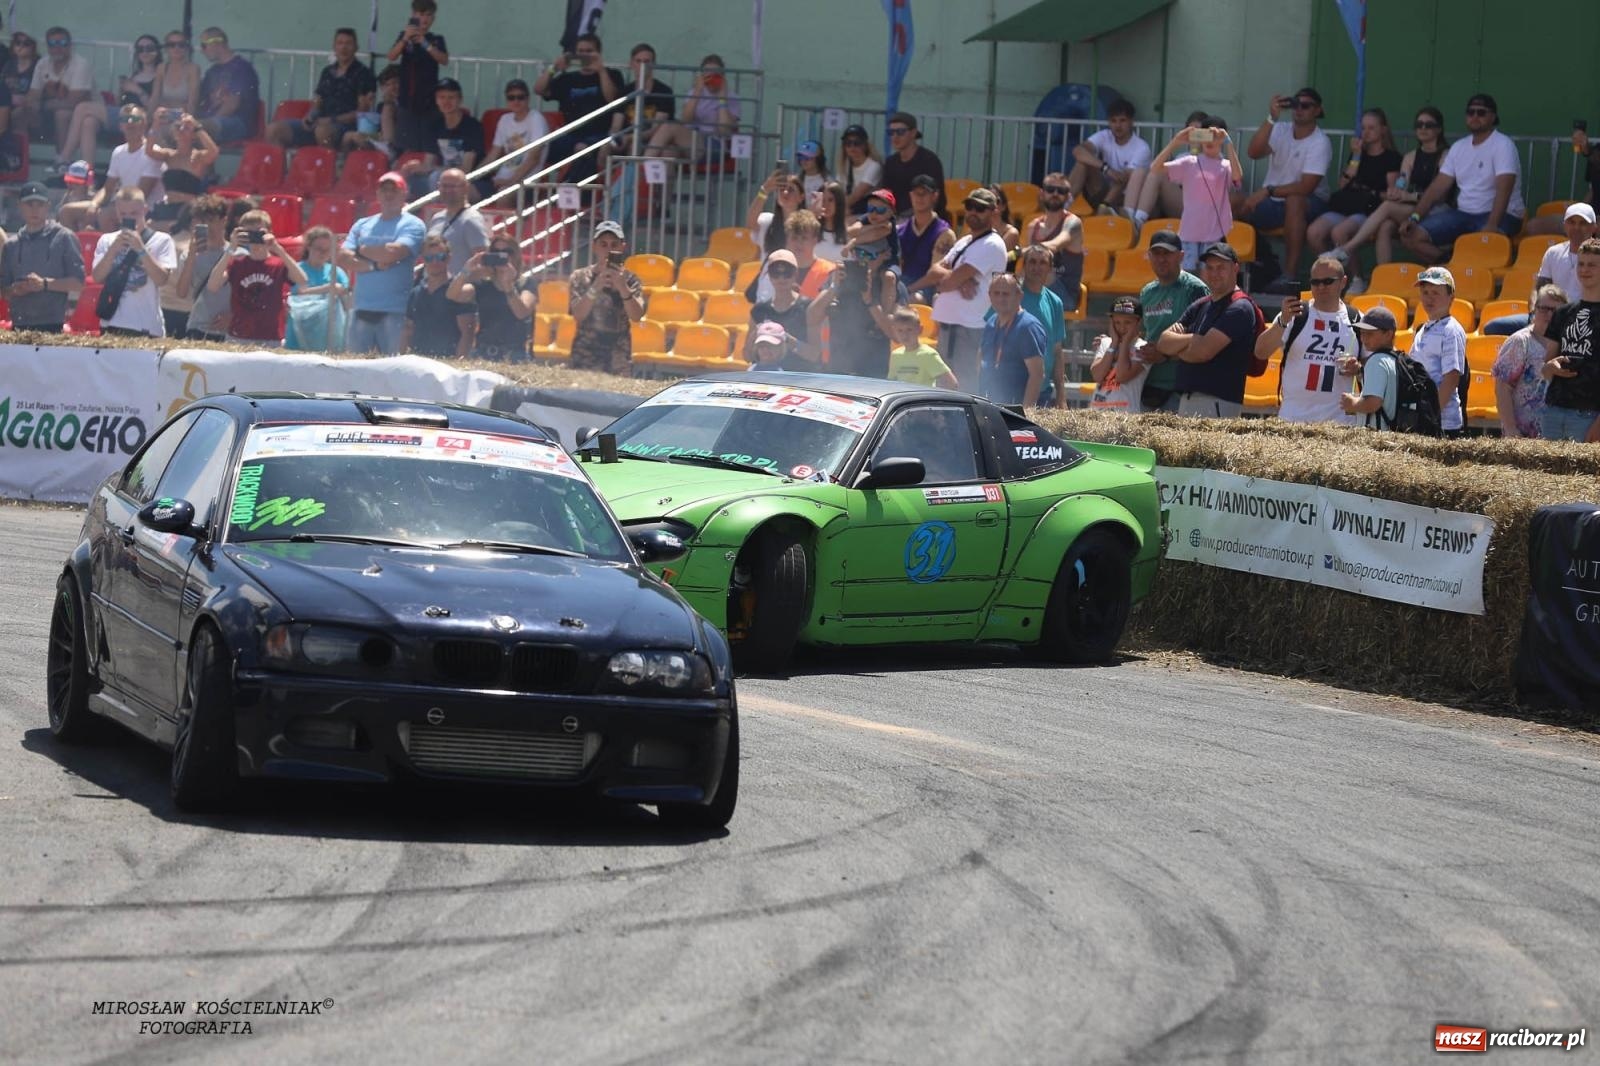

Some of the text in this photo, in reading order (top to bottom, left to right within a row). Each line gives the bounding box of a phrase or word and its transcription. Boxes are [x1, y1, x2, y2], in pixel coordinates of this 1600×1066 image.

[1561, 336, 1592, 356] DAKAR
[442, 437, 465, 449] 74
[796, 466, 809, 476] E
[231, 463, 265, 524] TRACKWOOD
[985, 486, 1000, 502] 031
[1215, 490, 1318, 526] NAMIOTOWYCH
[1332, 508, 1405, 544] WYNAJEM
[1423, 525, 1478, 554] SERWIS
[907, 529, 953, 578] 31
[1566, 558, 1600, 580] AUT
